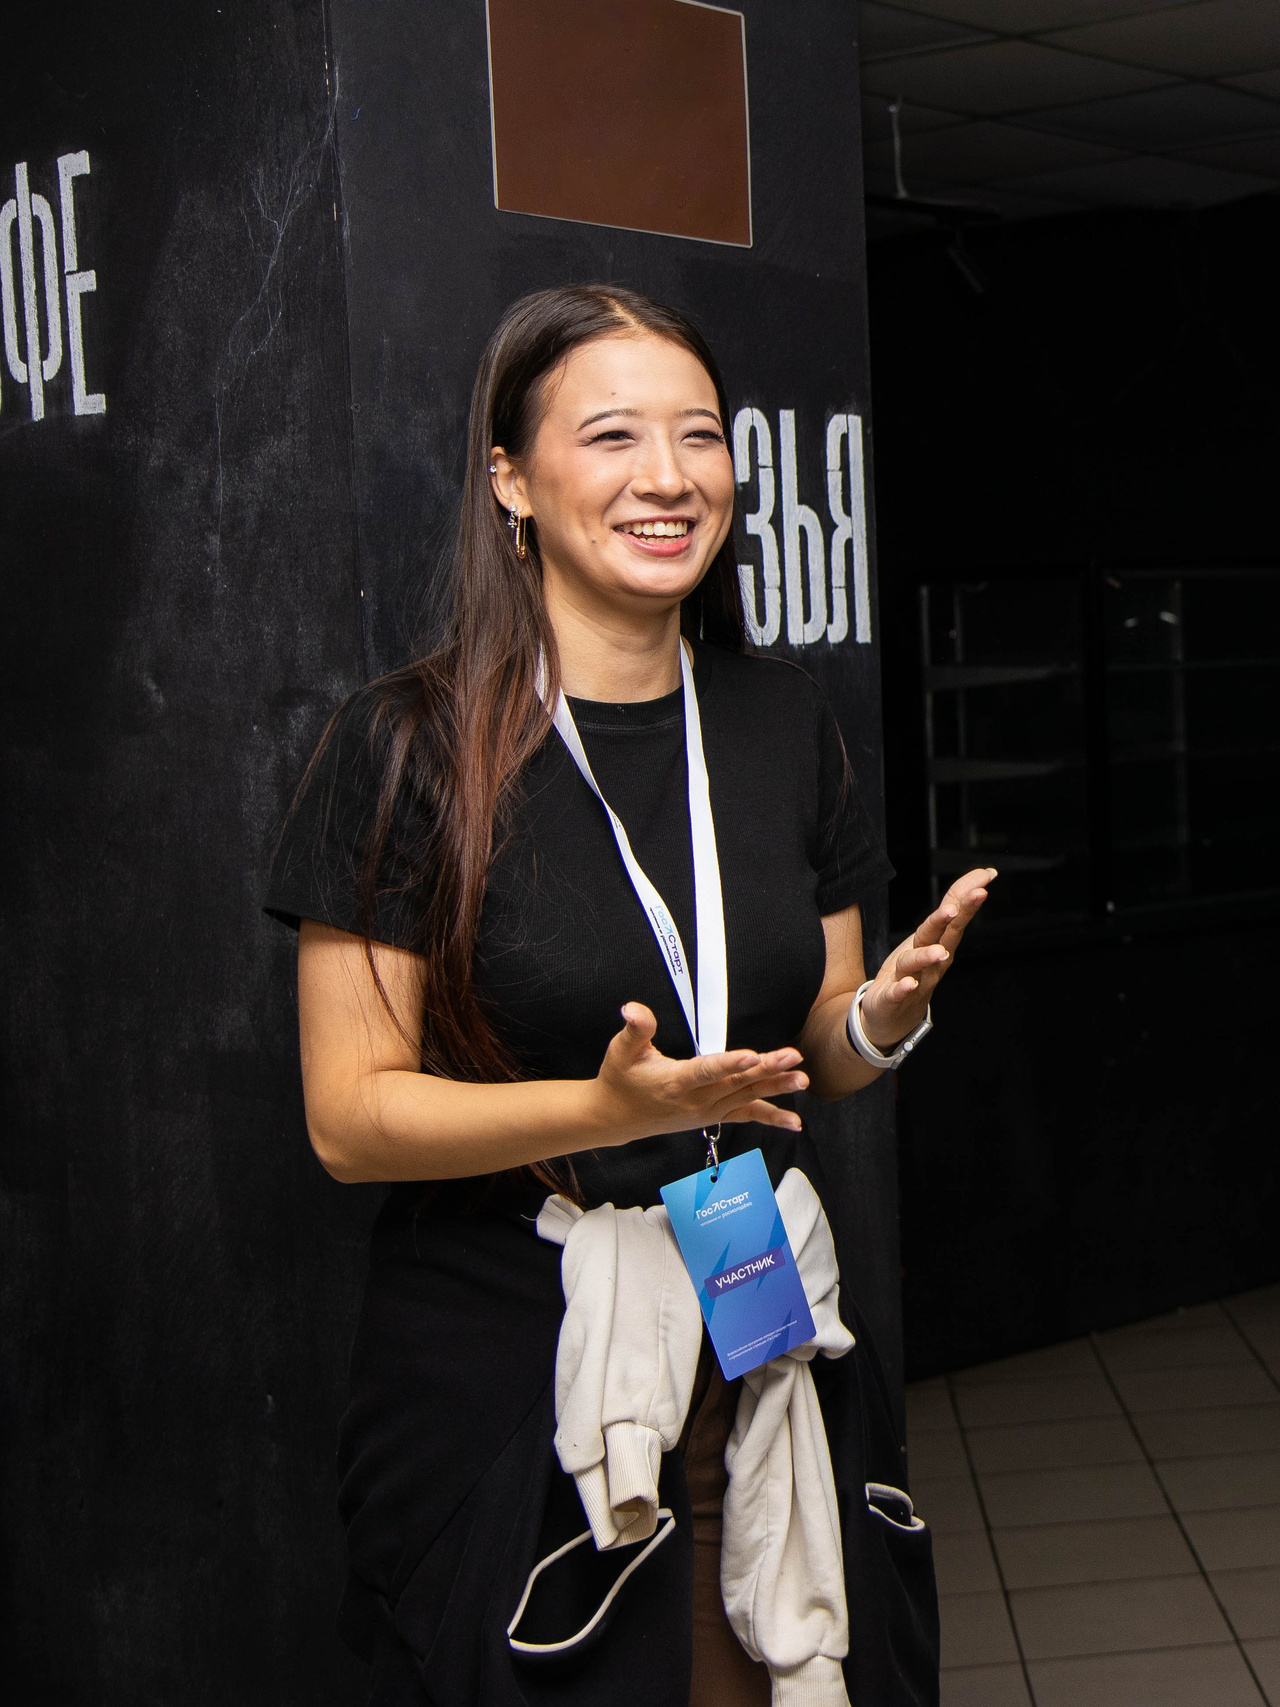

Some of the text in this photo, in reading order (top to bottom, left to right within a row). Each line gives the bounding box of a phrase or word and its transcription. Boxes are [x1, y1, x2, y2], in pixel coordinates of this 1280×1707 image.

[0, 150, 106, 421] ФЕ
[733, 407, 871, 646] ЗЬЯ
[715, 1254, 775, 1289] УЧАСТНИК
